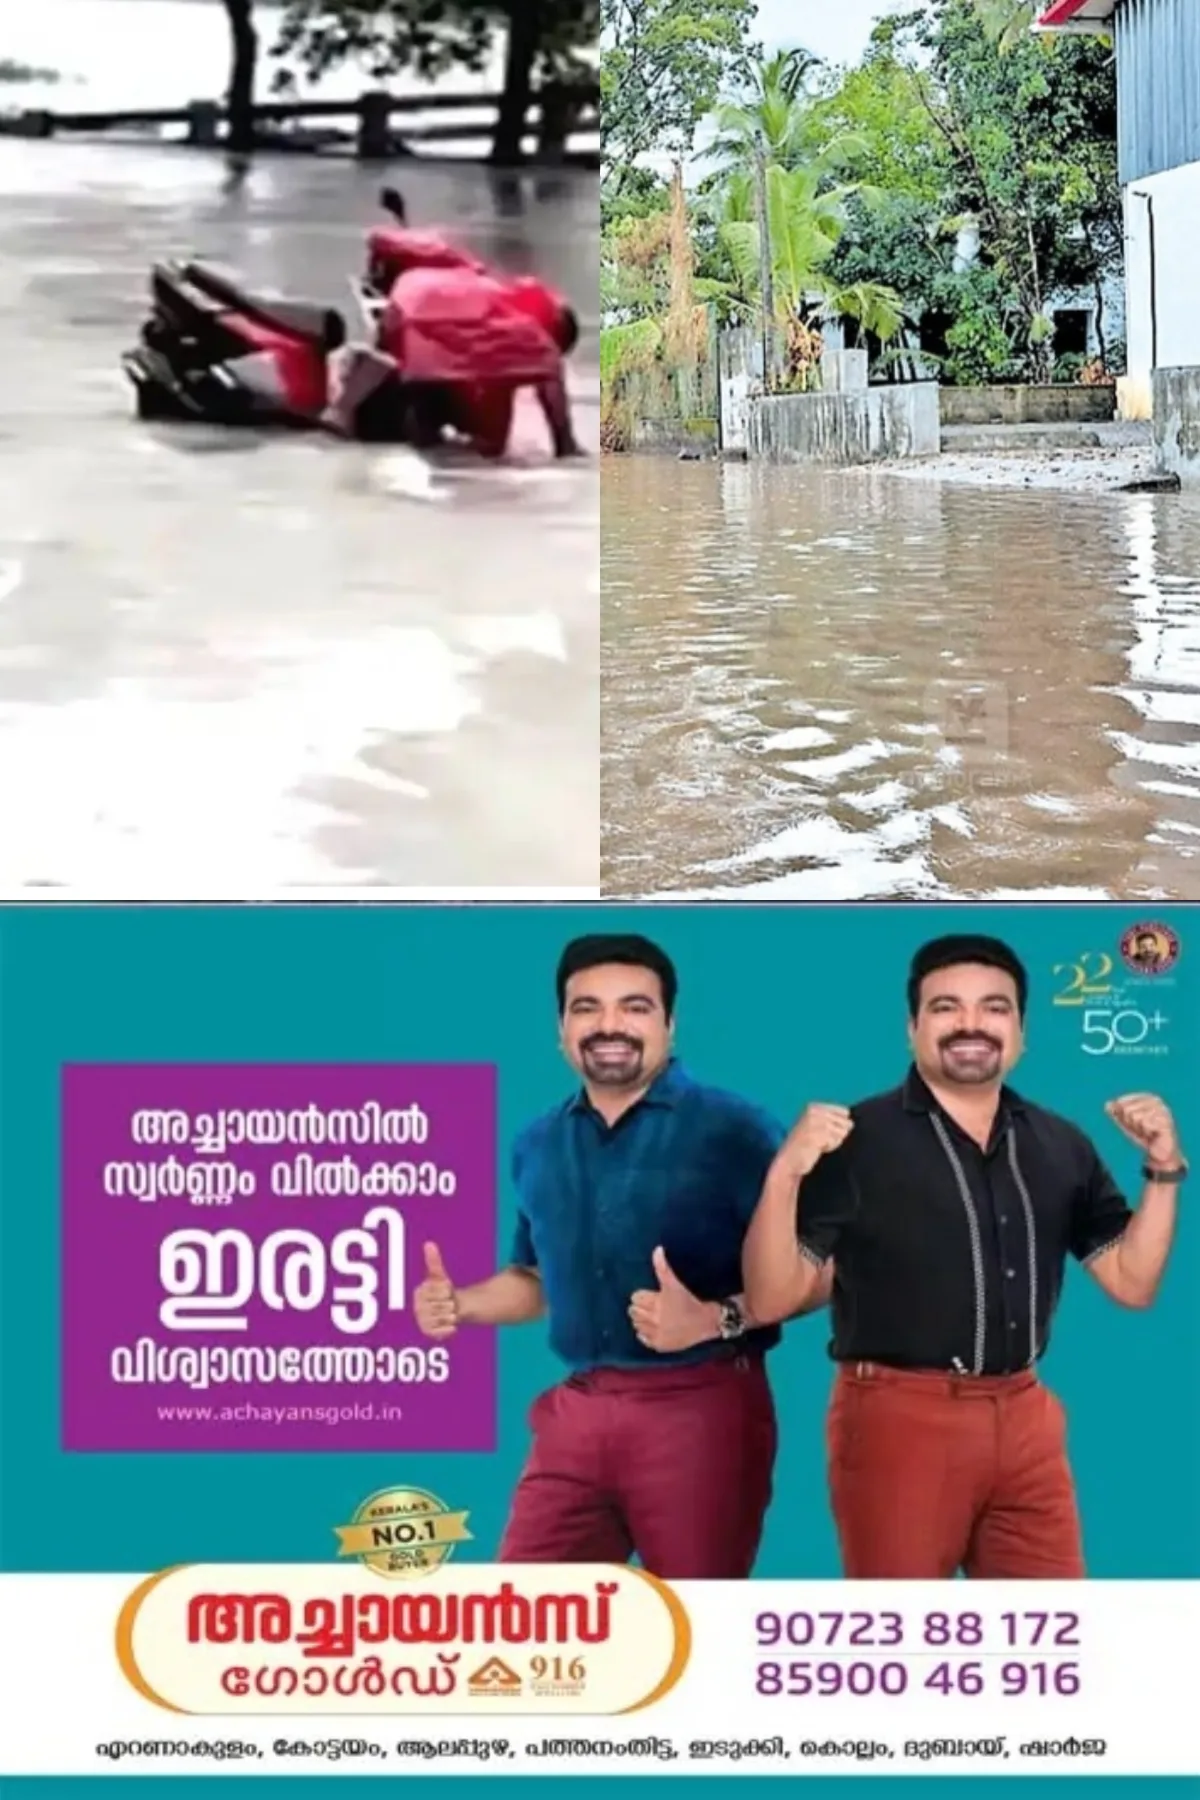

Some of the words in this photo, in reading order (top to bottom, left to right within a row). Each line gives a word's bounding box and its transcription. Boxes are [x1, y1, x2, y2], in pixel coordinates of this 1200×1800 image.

[1053, 952, 1112, 1006] 22
[1081, 1009, 1169, 1056] 50+
[132, 1101, 428, 1153] അച്ചായൻസിൽ
[272, 1153, 456, 1197] വിൽക്കാം
[159, 1206, 406, 1333] ഇരട്ടി
[111, 1338, 449, 1389] വിശ്വാസത്തോടെ
[157, 1403, 403, 1424] www.achayansgold.in
[371, 1520, 436, 1546] NO.1
[187, 1582, 618, 1657] അച്ചായൻസ്
[755, 1611, 904, 1646] 90723
[923, 1611, 983, 1646] 88
[1001, 1611, 1080, 1646] 172
[221, 1652, 461, 1696] ഗോൾഡ്
[529, 1655, 586, 1680] 916
[755, 1661, 908, 1696] 85900
[924, 1662, 984, 1696] 46
[1001, 1662, 1080, 1696] 916
